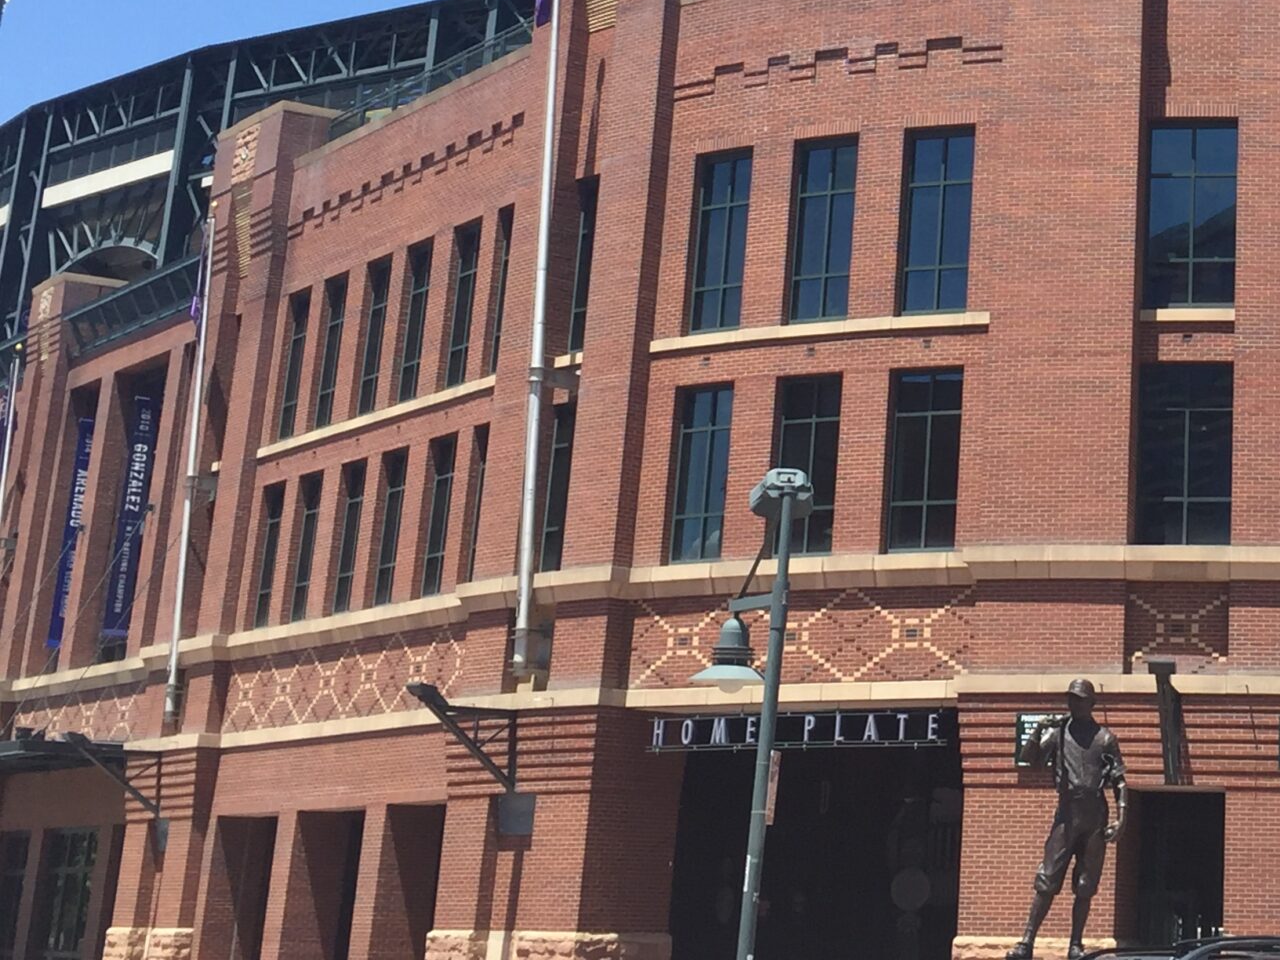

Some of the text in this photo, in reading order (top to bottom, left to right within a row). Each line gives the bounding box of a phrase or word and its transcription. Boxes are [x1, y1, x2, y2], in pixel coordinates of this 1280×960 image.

[124, 443, 149, 513] GONZALEZ
[652, 713, 940, 747] HOME PLATE
